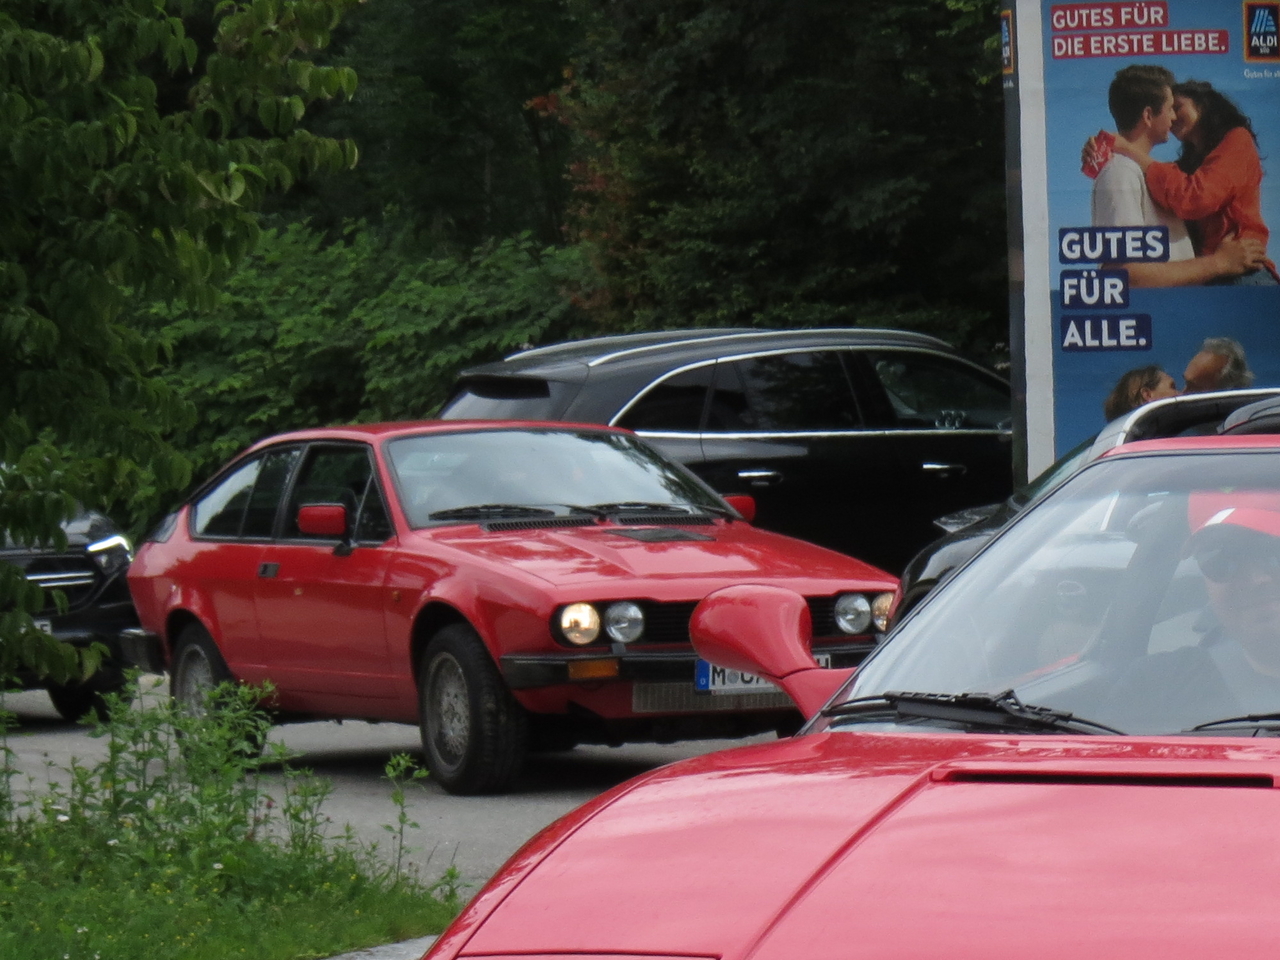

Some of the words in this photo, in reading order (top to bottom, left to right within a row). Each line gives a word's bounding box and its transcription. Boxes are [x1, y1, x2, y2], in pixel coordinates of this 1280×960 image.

[1053, 8, 1114, 29] GUTES
[1121, 3, 1164, 26] FÜR
[1054, 38, 1084, 57] DIE
[1090, 35, 1155, 54] ERSTE
[1161, 33, 1226, 52] LIEBE.
[1251, 35, 1278, 47] ALDI
[1060, 230, 1164, 259] GUTES
[1063, 271, 1125, 305] FÜR
[1062, 319, 1147, 348] ALLE.
[711, 665, 726, 686] M
